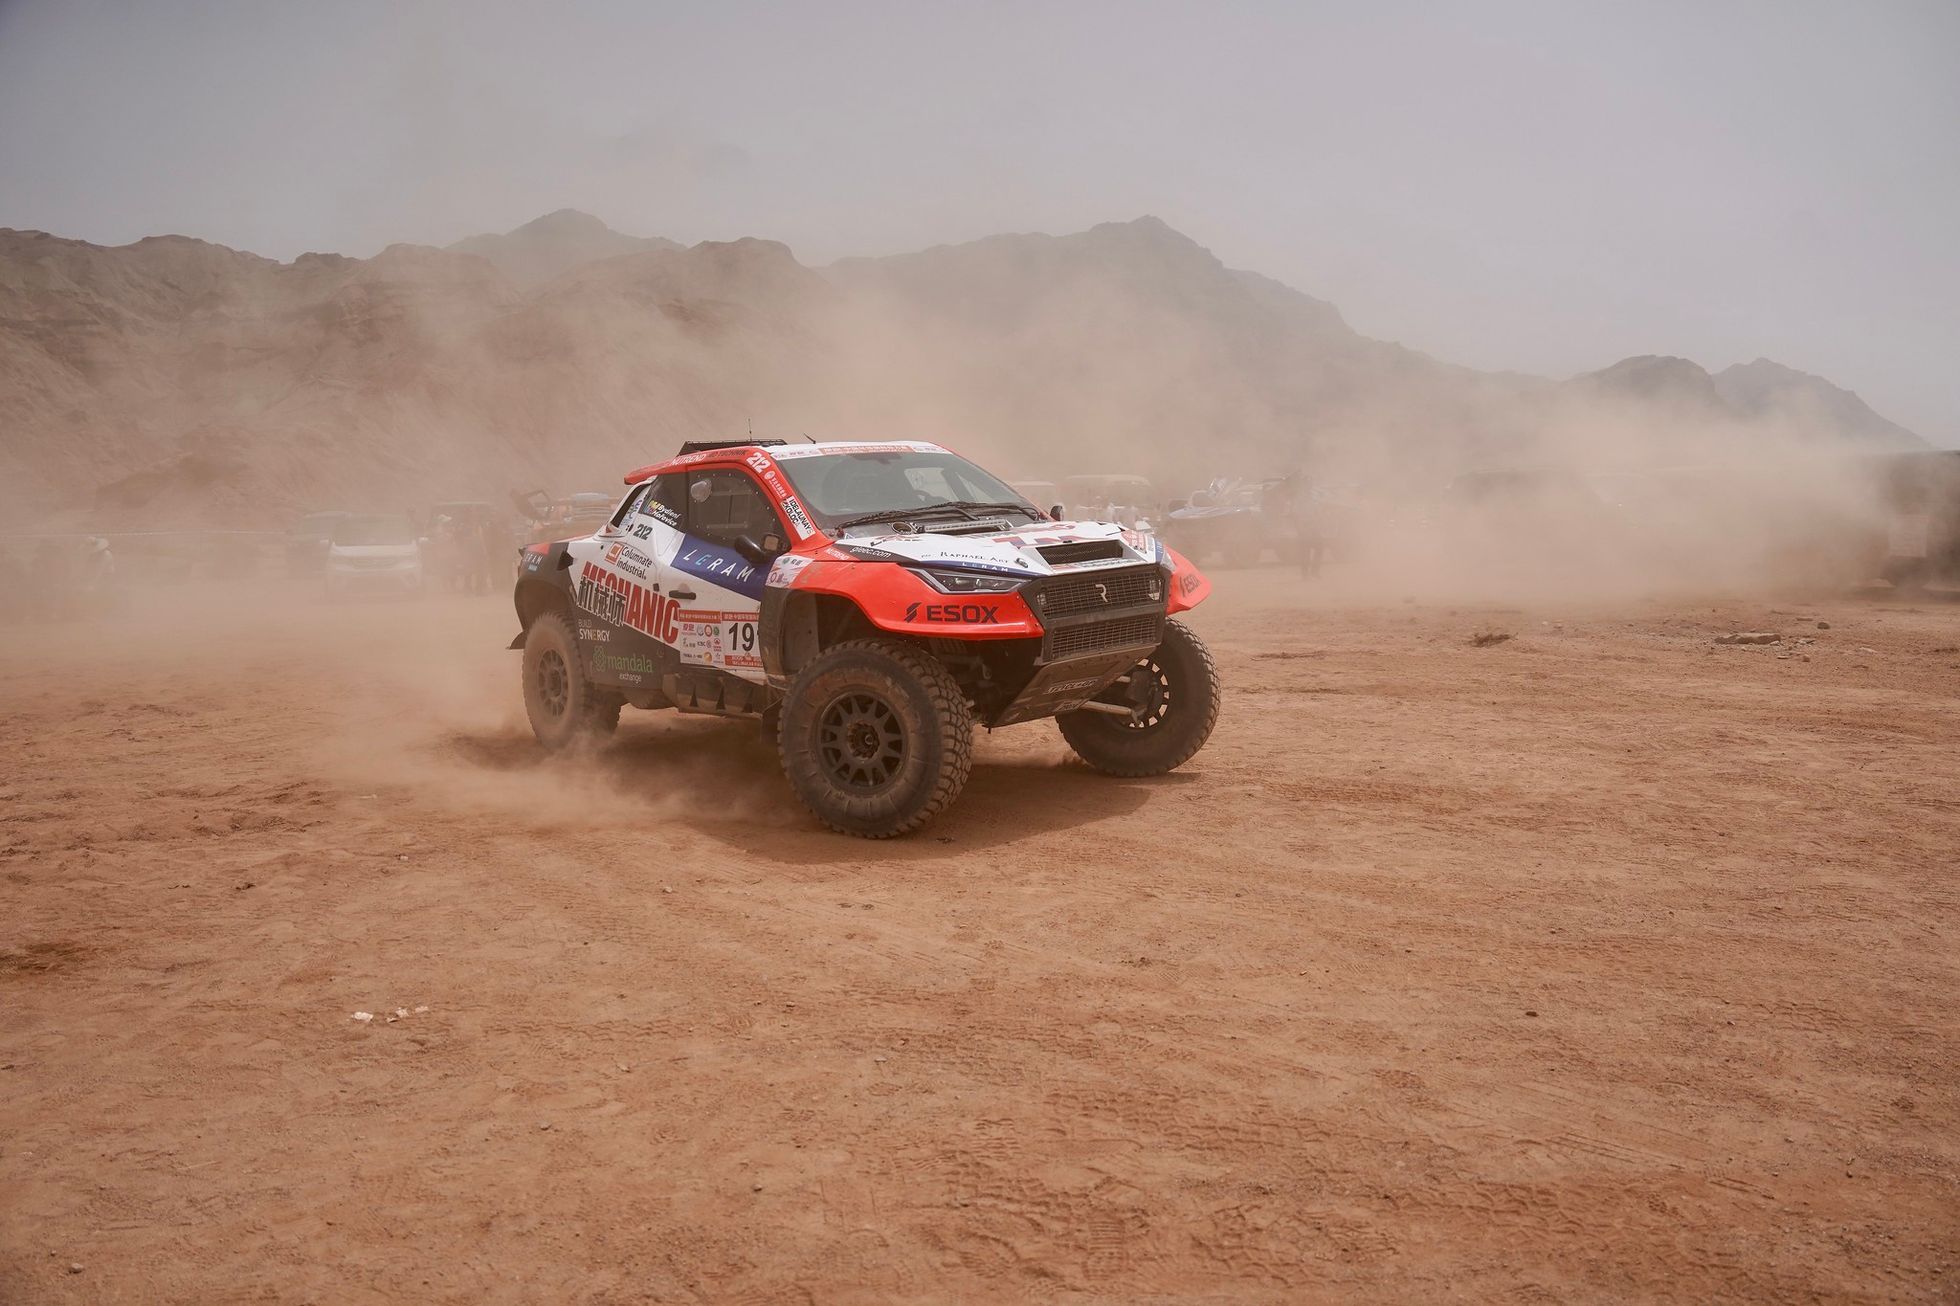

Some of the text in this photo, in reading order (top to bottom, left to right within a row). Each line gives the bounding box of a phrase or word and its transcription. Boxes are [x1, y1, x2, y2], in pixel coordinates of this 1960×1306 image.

[746, 452, 771, 473] 212
[633, 524, 653, 540] 212
[622, 546, 652, 568] Columnate
[926, 604, 999, 625] ESOX
[579, 628, 611, 642] SYNERGY
[728, 622, 761, 651] 19
[607, 655, 653, 673] mandala
